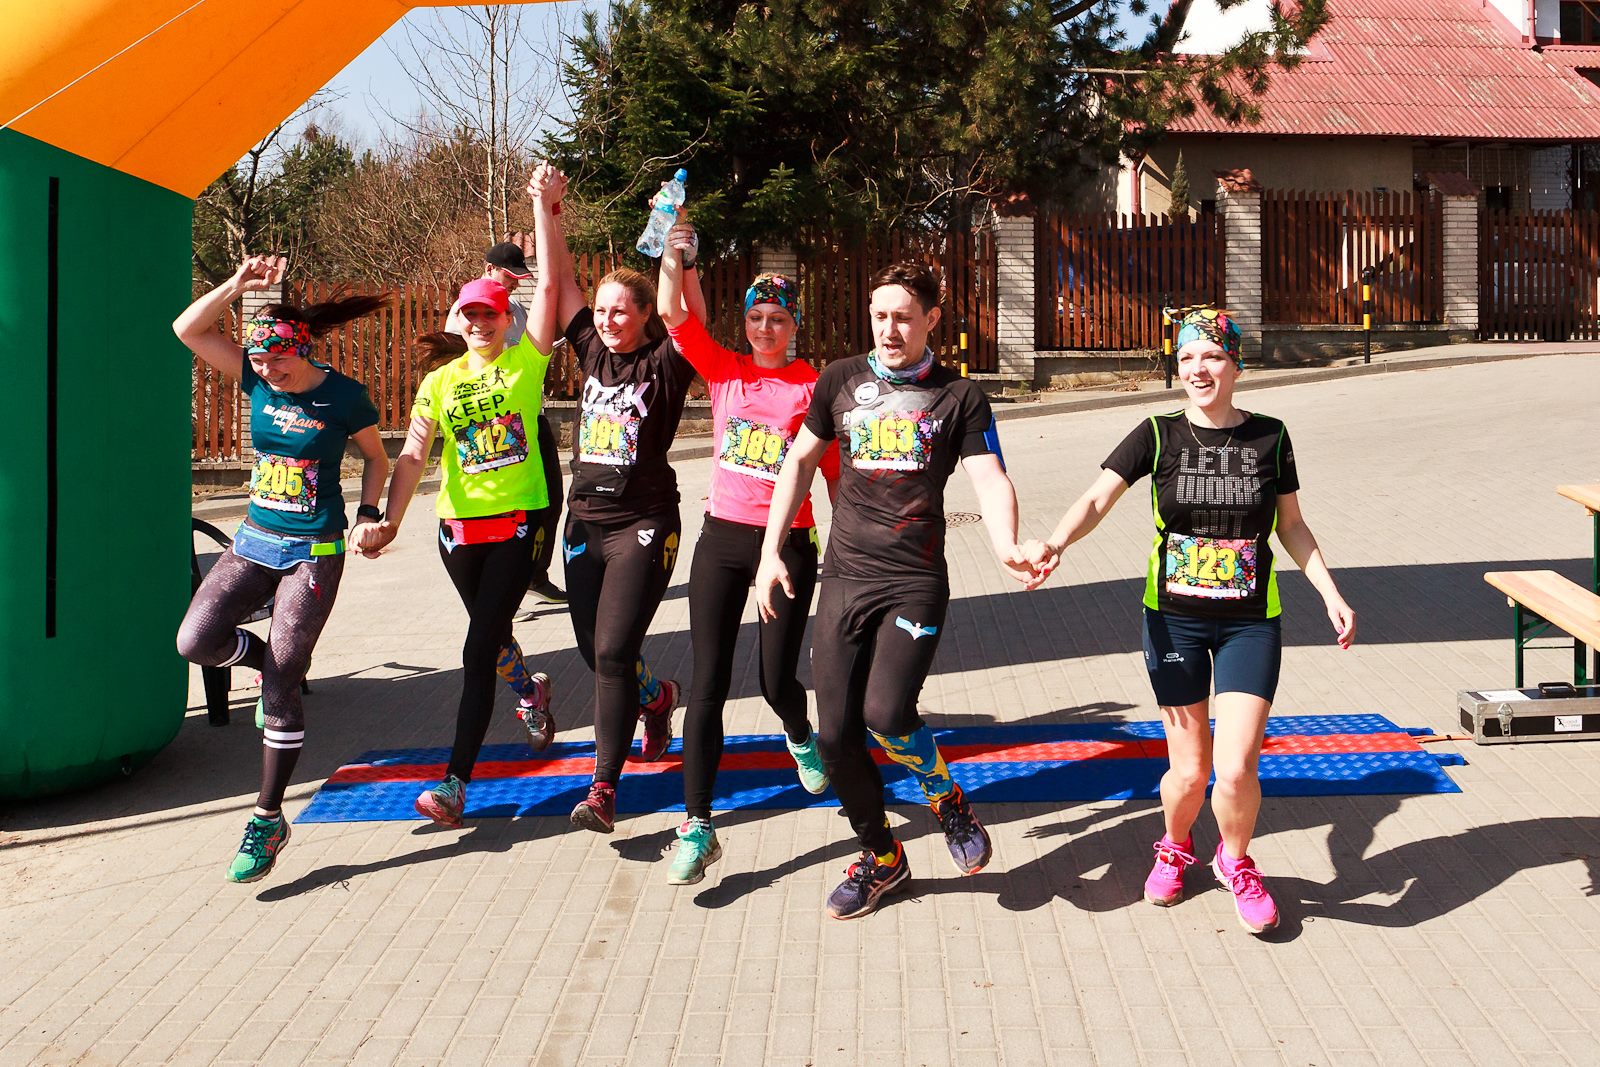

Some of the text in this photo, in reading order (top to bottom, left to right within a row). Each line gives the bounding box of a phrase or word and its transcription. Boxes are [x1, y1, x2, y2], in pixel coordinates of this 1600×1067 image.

[446, 393, 505, 423] KEEP
[472, 423, 511, 456] 112
[588, 418, 621, 450] 191
[738, 427, 782, 465] 189
[869, 418, 915, 453] 163
[1180, 446, 1259, 475] LET'S
[257, 461, 303, 497] 205
[1175, 475, 1262, 505] WORK
[1190, 509, 1249, 537] OUT
[1185, 545, 1236, 581] 123
